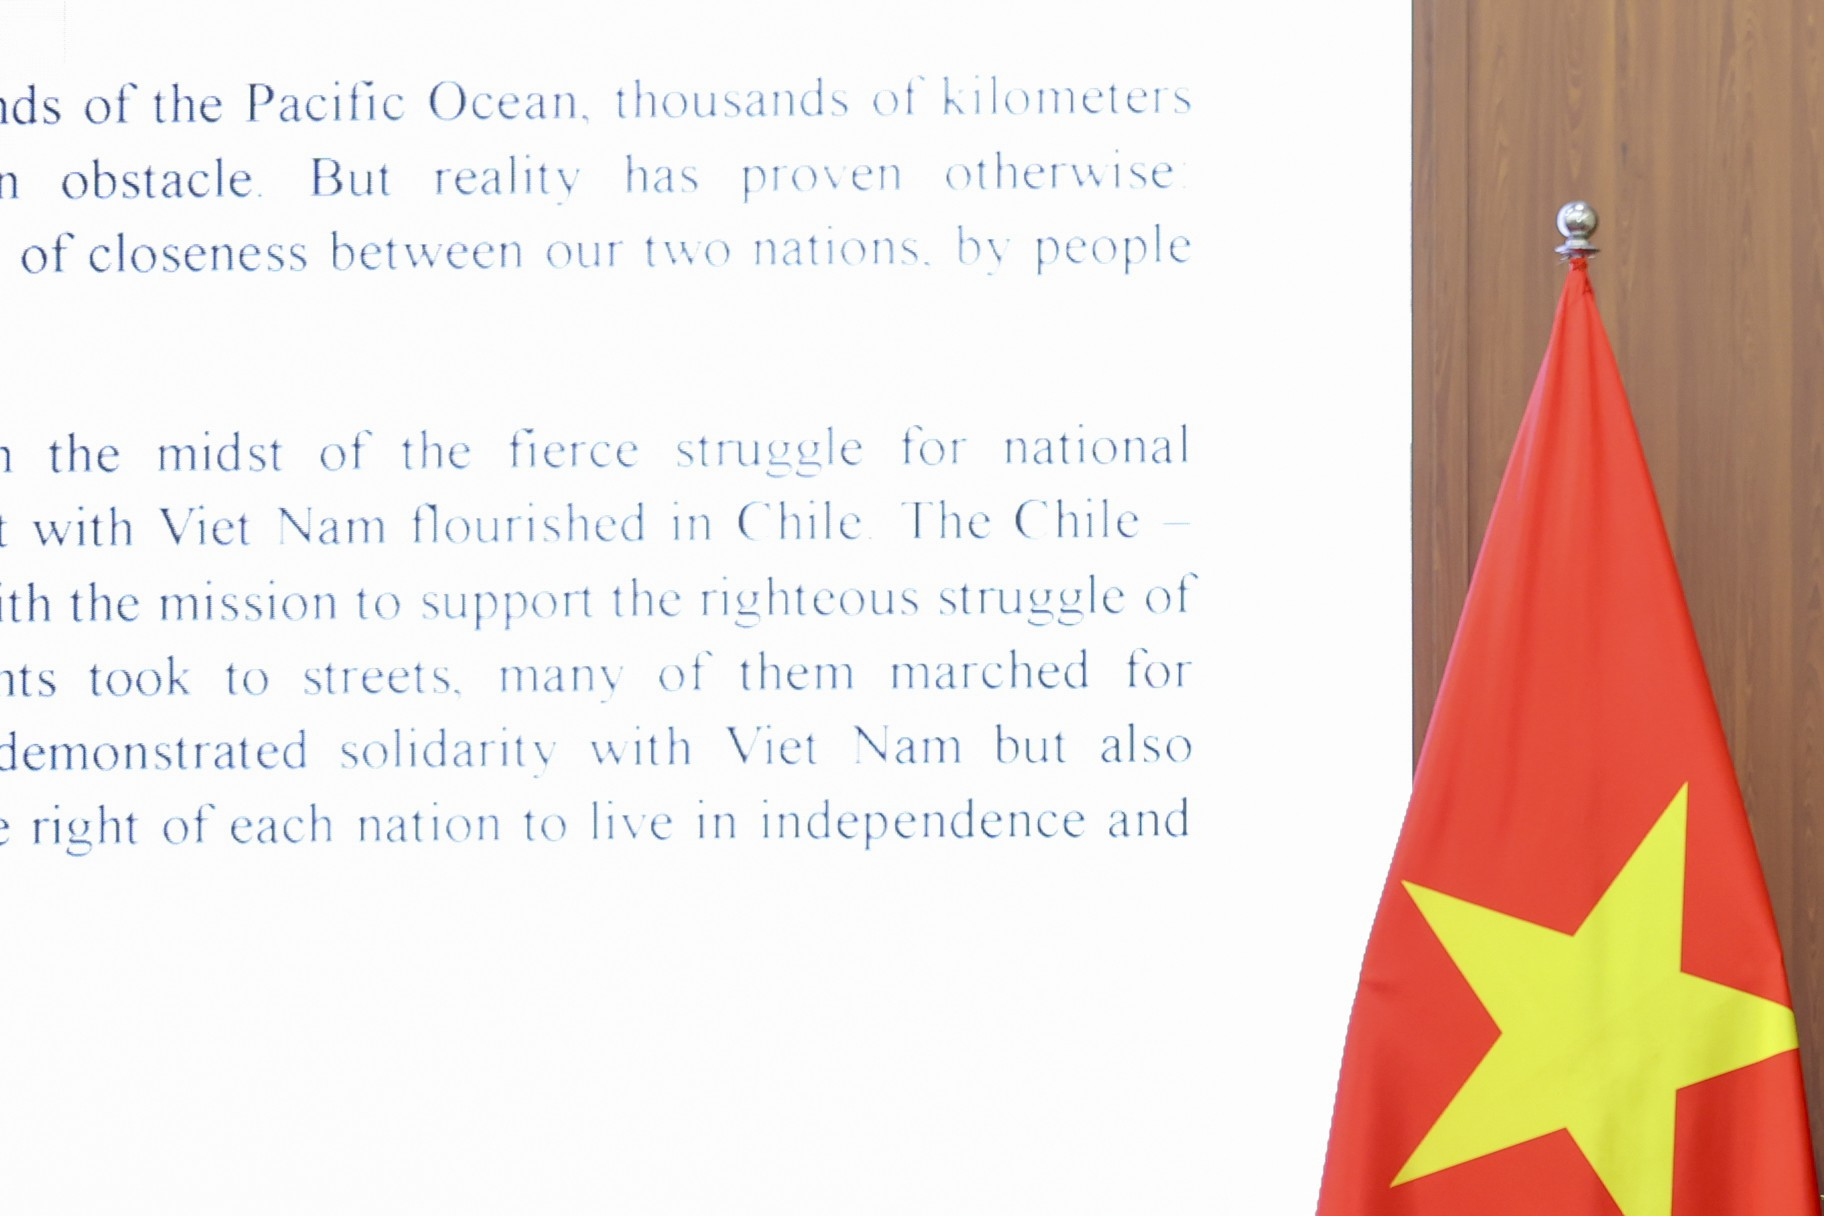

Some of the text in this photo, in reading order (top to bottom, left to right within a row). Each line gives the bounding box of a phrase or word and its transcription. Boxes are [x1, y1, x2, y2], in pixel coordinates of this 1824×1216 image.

[84, 82, 139, 125] of
[152, 81, 223, 125] the
[245, 80, 405, 124] Pacific
[615, 76, 849, 120] thousands
[873, 74, 926, 117] of
[942, 74, 1193, 116] kilometers
[61, 156, 263, 201] obstacle.
[310, 156, 392, 198] But
[434, 154, 581, 206] reality
[625, 153, 699, 194] has
[742, 164, 901, 204] proven
[20, 230, 76, 275] of
[88, 232, 308, 274] closeness
[330, 230, 522, 272] between
[546, 240, 624, 269] our
[645, 235, 732, 268] two
[957, 224, 1011, 277] by
[1036, 223, 1192, 277] people
[47, 432, 120, 475] the
[158, 430, 284, 473] midst
[320, 428, 374, 472] of
[401, 428, 472, 471] the
[509, 428, 639, 470] fierce
[677, 425, 863, 479] struggle
[901, 425, 968, 467] for
[1005, 423, 1188, 466] national
[32, 505, 133, 548] with
[158, 504, 251, 548] Viet
[277, 505, 386, 546] Nam
[411, 501, 645, 544] flourished
[673, 500, 711, 544] in
[901, 499, 991, 541] The
[1015, 497, 1140, 540] Chile
[69, 581, 140, 624] the
[160, 579, 336, 623] mission
[355, 587, 401, 621] to
[422, 585, 593, 632] support
[612, 576, 682, 618] the
[701, 576, 920, 629] righteous
[939, 573, 1125, 628] struggle
[1145, 572, 1200, 615] of
[88, 655, 192, 698] took
[225, 662, 270, 697] to
[499, 664, 624, 704] many
[658, 649, 714, 692] of
[739, 650, 854, 693] them
[891, 648, 1089, 691] marched
[1126, 647, 1193, 689] for
[340, 726, 557, 779] solidarity
[590, 725, 691, 767] with
[725, 724, 817, 766] Viet
[853, 725, 961, 765] Nam
[995, 722, 1067, 765] but
[1101, 722, 1193, 764] also
[32, 804, 139, 858] right
[162, 802, 217, 846] of
[230, 802, 333, 845] each
[358, 801, 500, 843] nation
[523, 809, 567, 842] to
[592, 800, 673, 842] live
[697, 799, 736, 840] in
[762, 797, 1086, 853] independence
[1108, 796, 1189, 840] and
